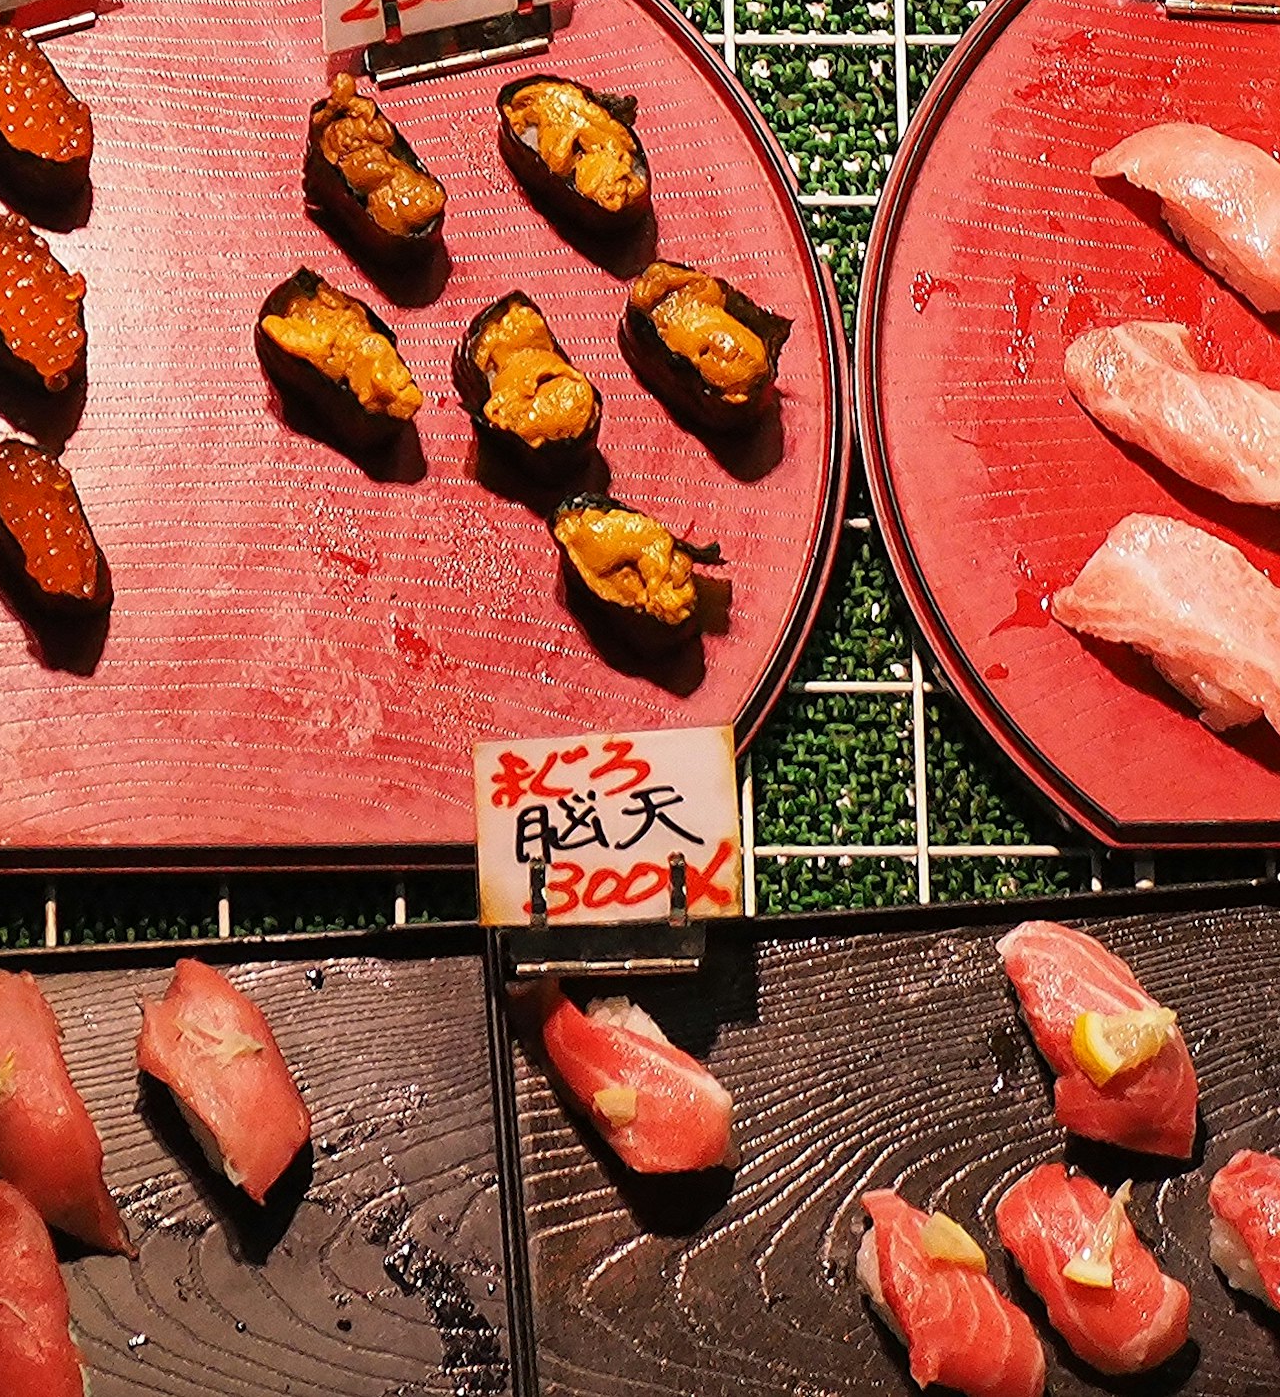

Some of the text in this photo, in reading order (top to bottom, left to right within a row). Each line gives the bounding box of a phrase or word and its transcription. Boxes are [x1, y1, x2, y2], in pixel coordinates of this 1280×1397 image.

[491, 740, 652, 809] まぐろ
[515, 785, 705, 864] 脳天
